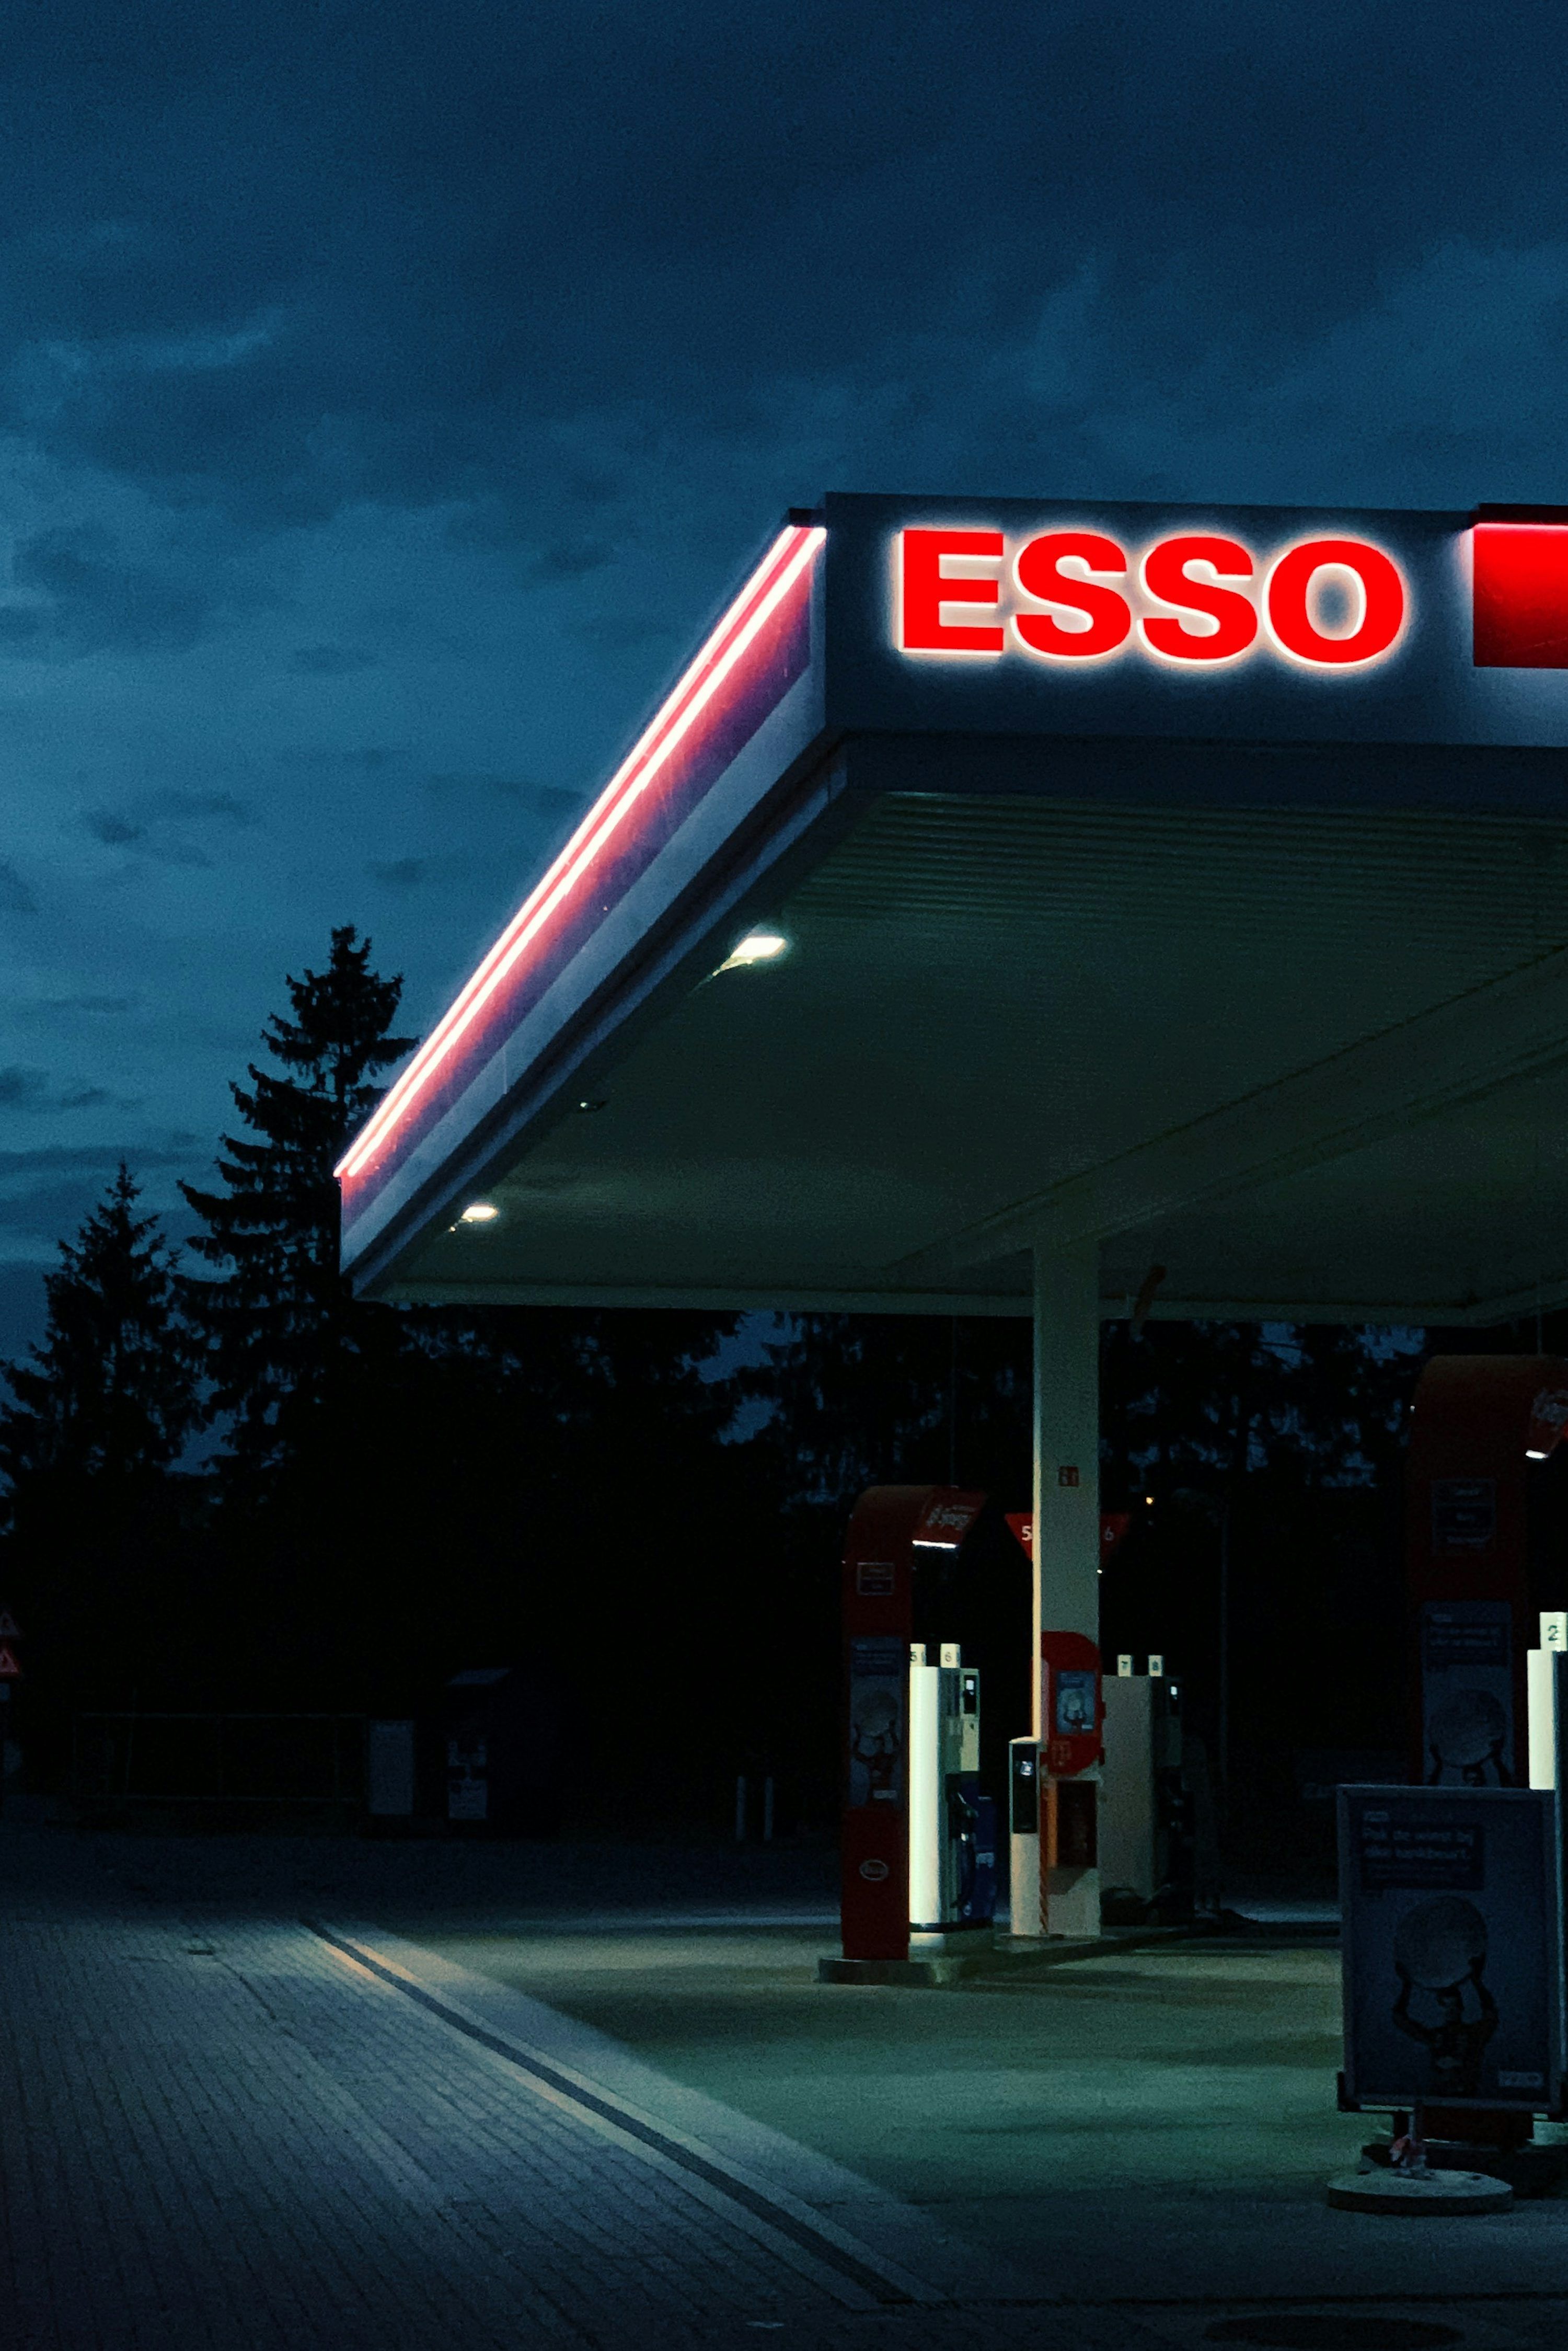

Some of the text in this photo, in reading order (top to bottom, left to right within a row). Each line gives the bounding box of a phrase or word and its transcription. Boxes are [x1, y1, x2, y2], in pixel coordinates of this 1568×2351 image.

[898, 529, 1404, 668] ESSO
[1021, 1525, 1033, 1542] 5
[1103, 1525, 1115, 1542] 6
[1547, 1624, 1558, 1641] 2
[909, 1651, 918, 1662] 5
[944, 1651, 952, 1662] 6
